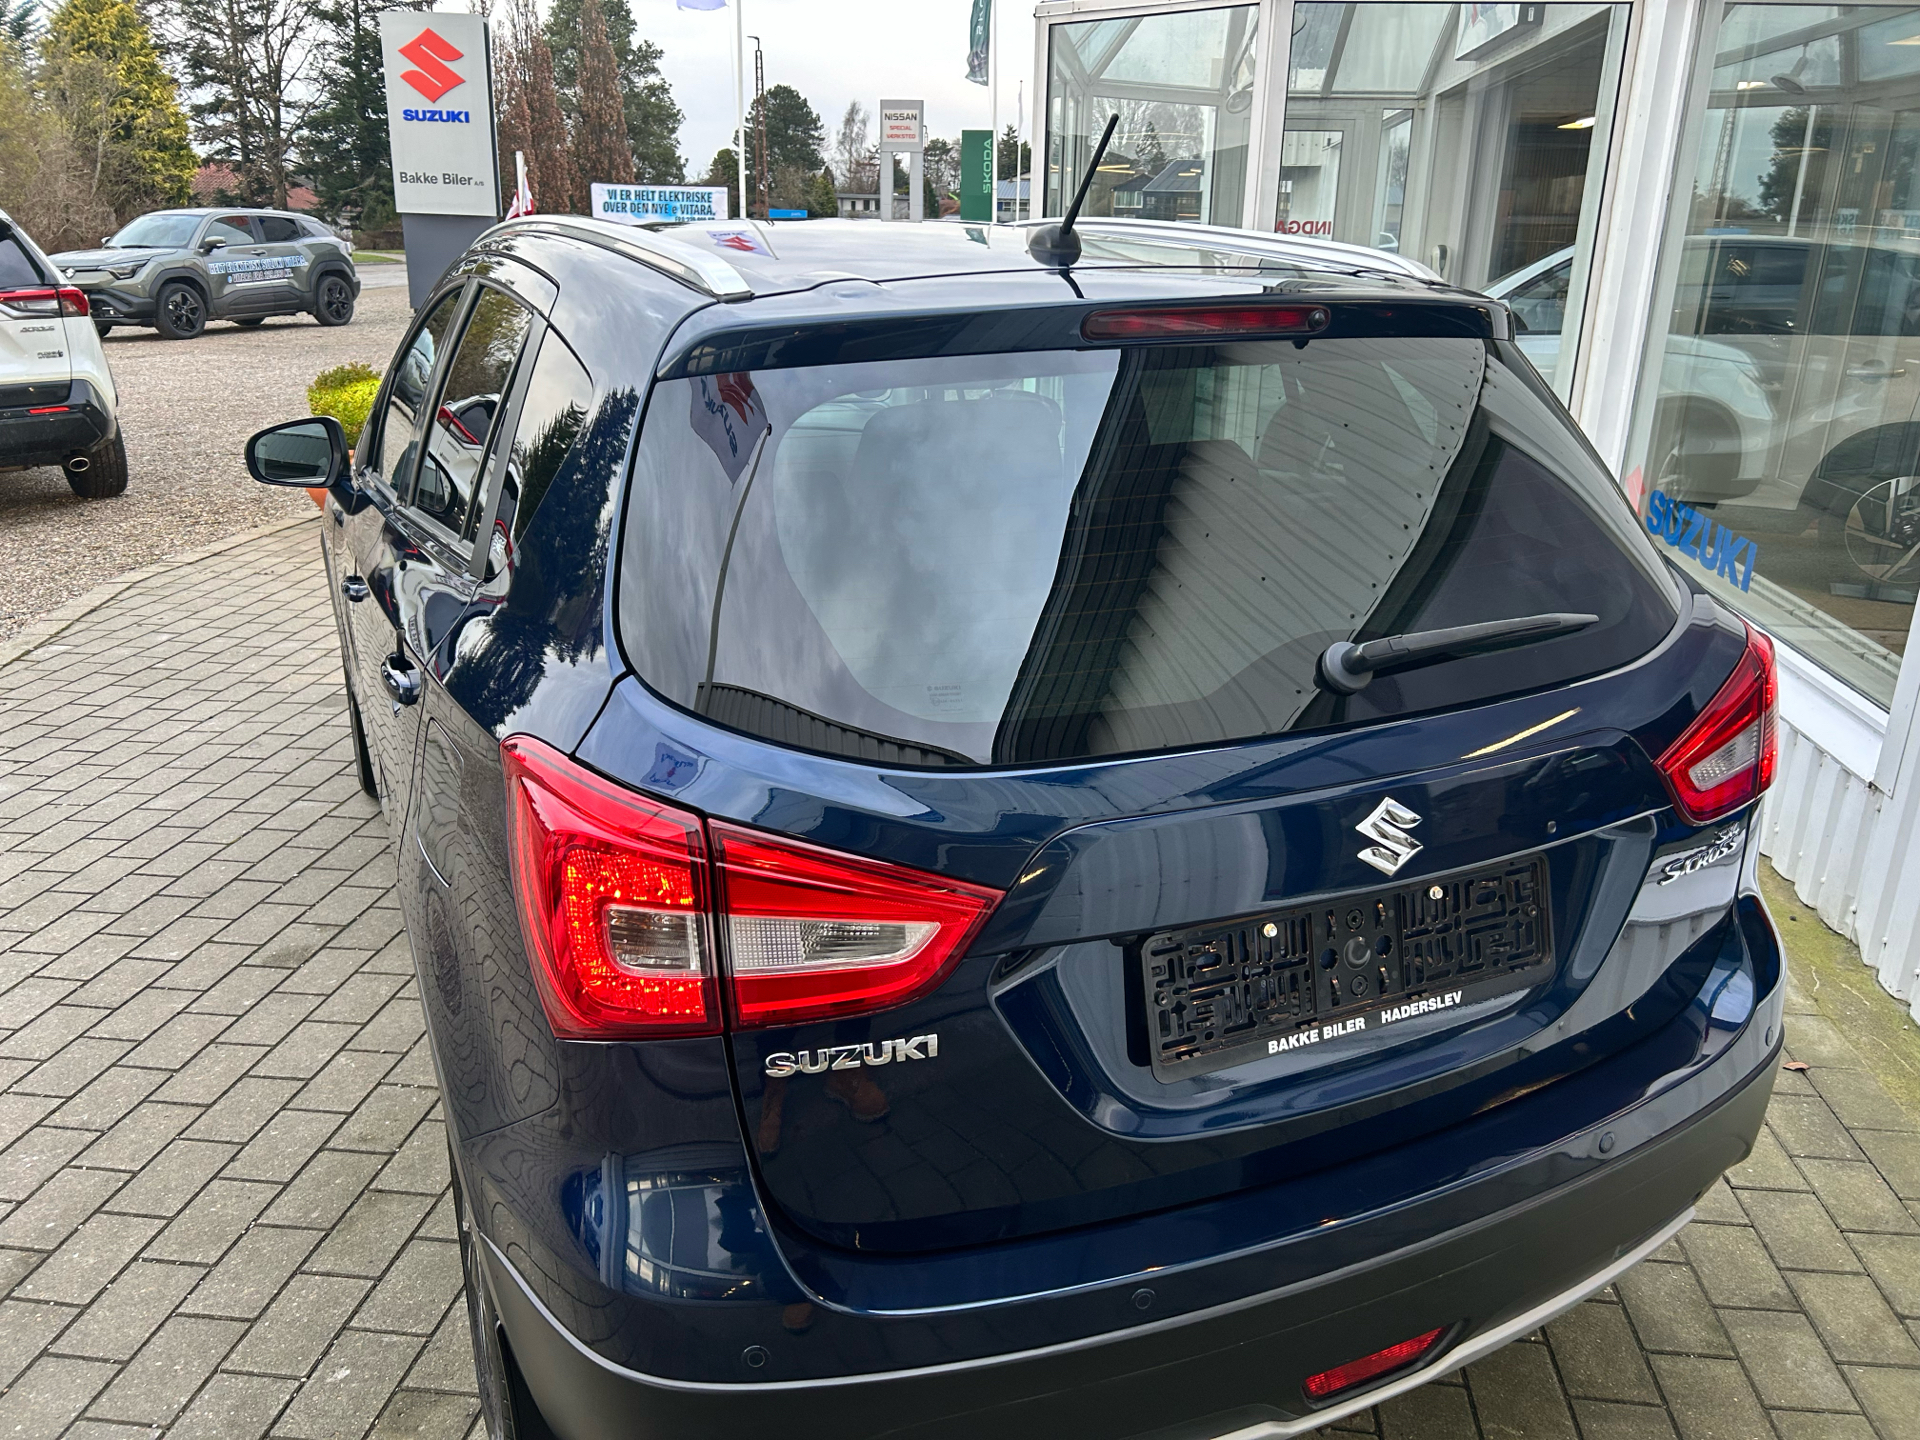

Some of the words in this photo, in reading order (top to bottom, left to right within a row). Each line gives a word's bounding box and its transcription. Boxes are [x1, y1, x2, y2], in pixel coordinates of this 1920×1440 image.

[403, 109, 470, 123] SUZUKI
[884, 113, 918, 121] NISSAN
[400, 172, 438, 184] Bakke
[442, 173, 473, 186] Biler
[607, 189, 617, 200] VI
[620, 189, 632, 201] ER
[634, 190, 656, 201] HELT
[659, 191, 713, 203] ELEKTRISKE
[603, 201, 627, 213] OVER
[630, 203, 649, 213] DEN
[651, 203, 669, 215] NYE
[672, 205, 677, 214] e
[680, 204, 716, 216] VITARA.
[209, 263, 226, 274] HELT
[1646, 489, 1758, 594] SUZUKI
[1268, 1029, 1319, 1054] BAKKE
[1323, 1017, 1366, 1040] BILER
[1381, 990, 1463, 1024] HADERSLEV
[765, 1033, 938, 1077] SUZUKI
